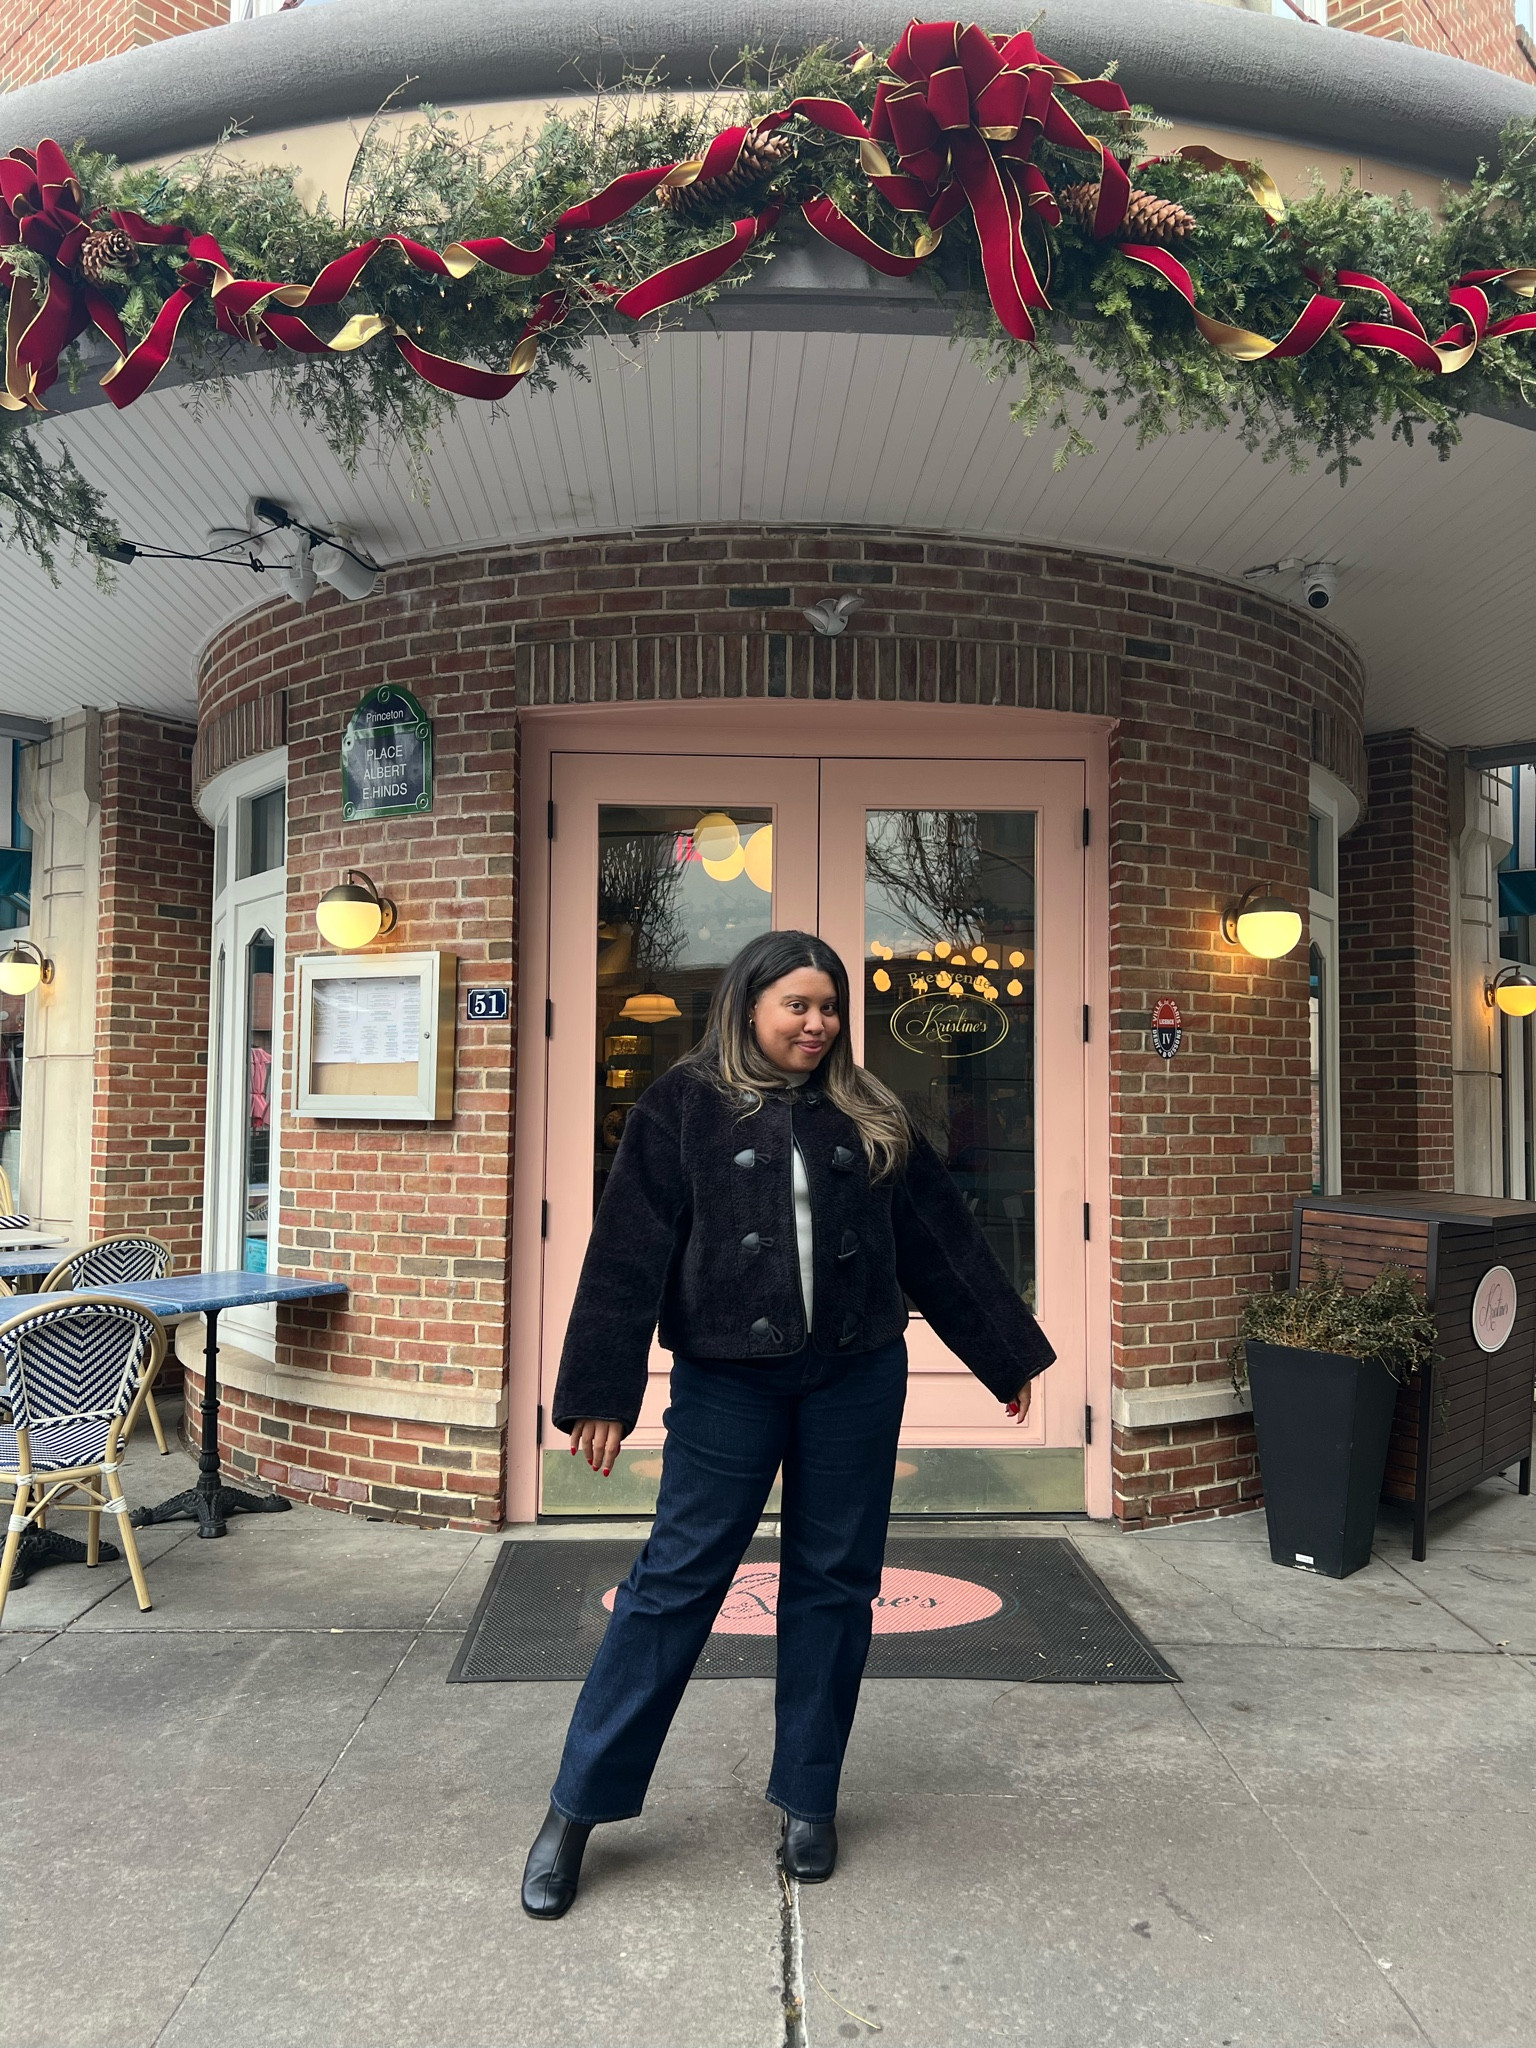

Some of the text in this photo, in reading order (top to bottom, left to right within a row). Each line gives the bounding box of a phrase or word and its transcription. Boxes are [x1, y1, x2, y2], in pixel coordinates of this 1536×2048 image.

[366, 709, 404, 723] Princeton
[366, 744, 404, 761] PLACE
[363, 763, 407, 780] ALBERT
[362, 782, 408, 800] E.HINDS
[907, 971, 993, 990] Bienvenue
[474, 994, 499, 1015] 51
[1152, 1000, 1163, 1022] VILLE
[1170, 1000, 1182, 1024] PARIS
[905, 1003, 988, 1043] Kristine's
[1162, 1033, 1172, 1045] IV
